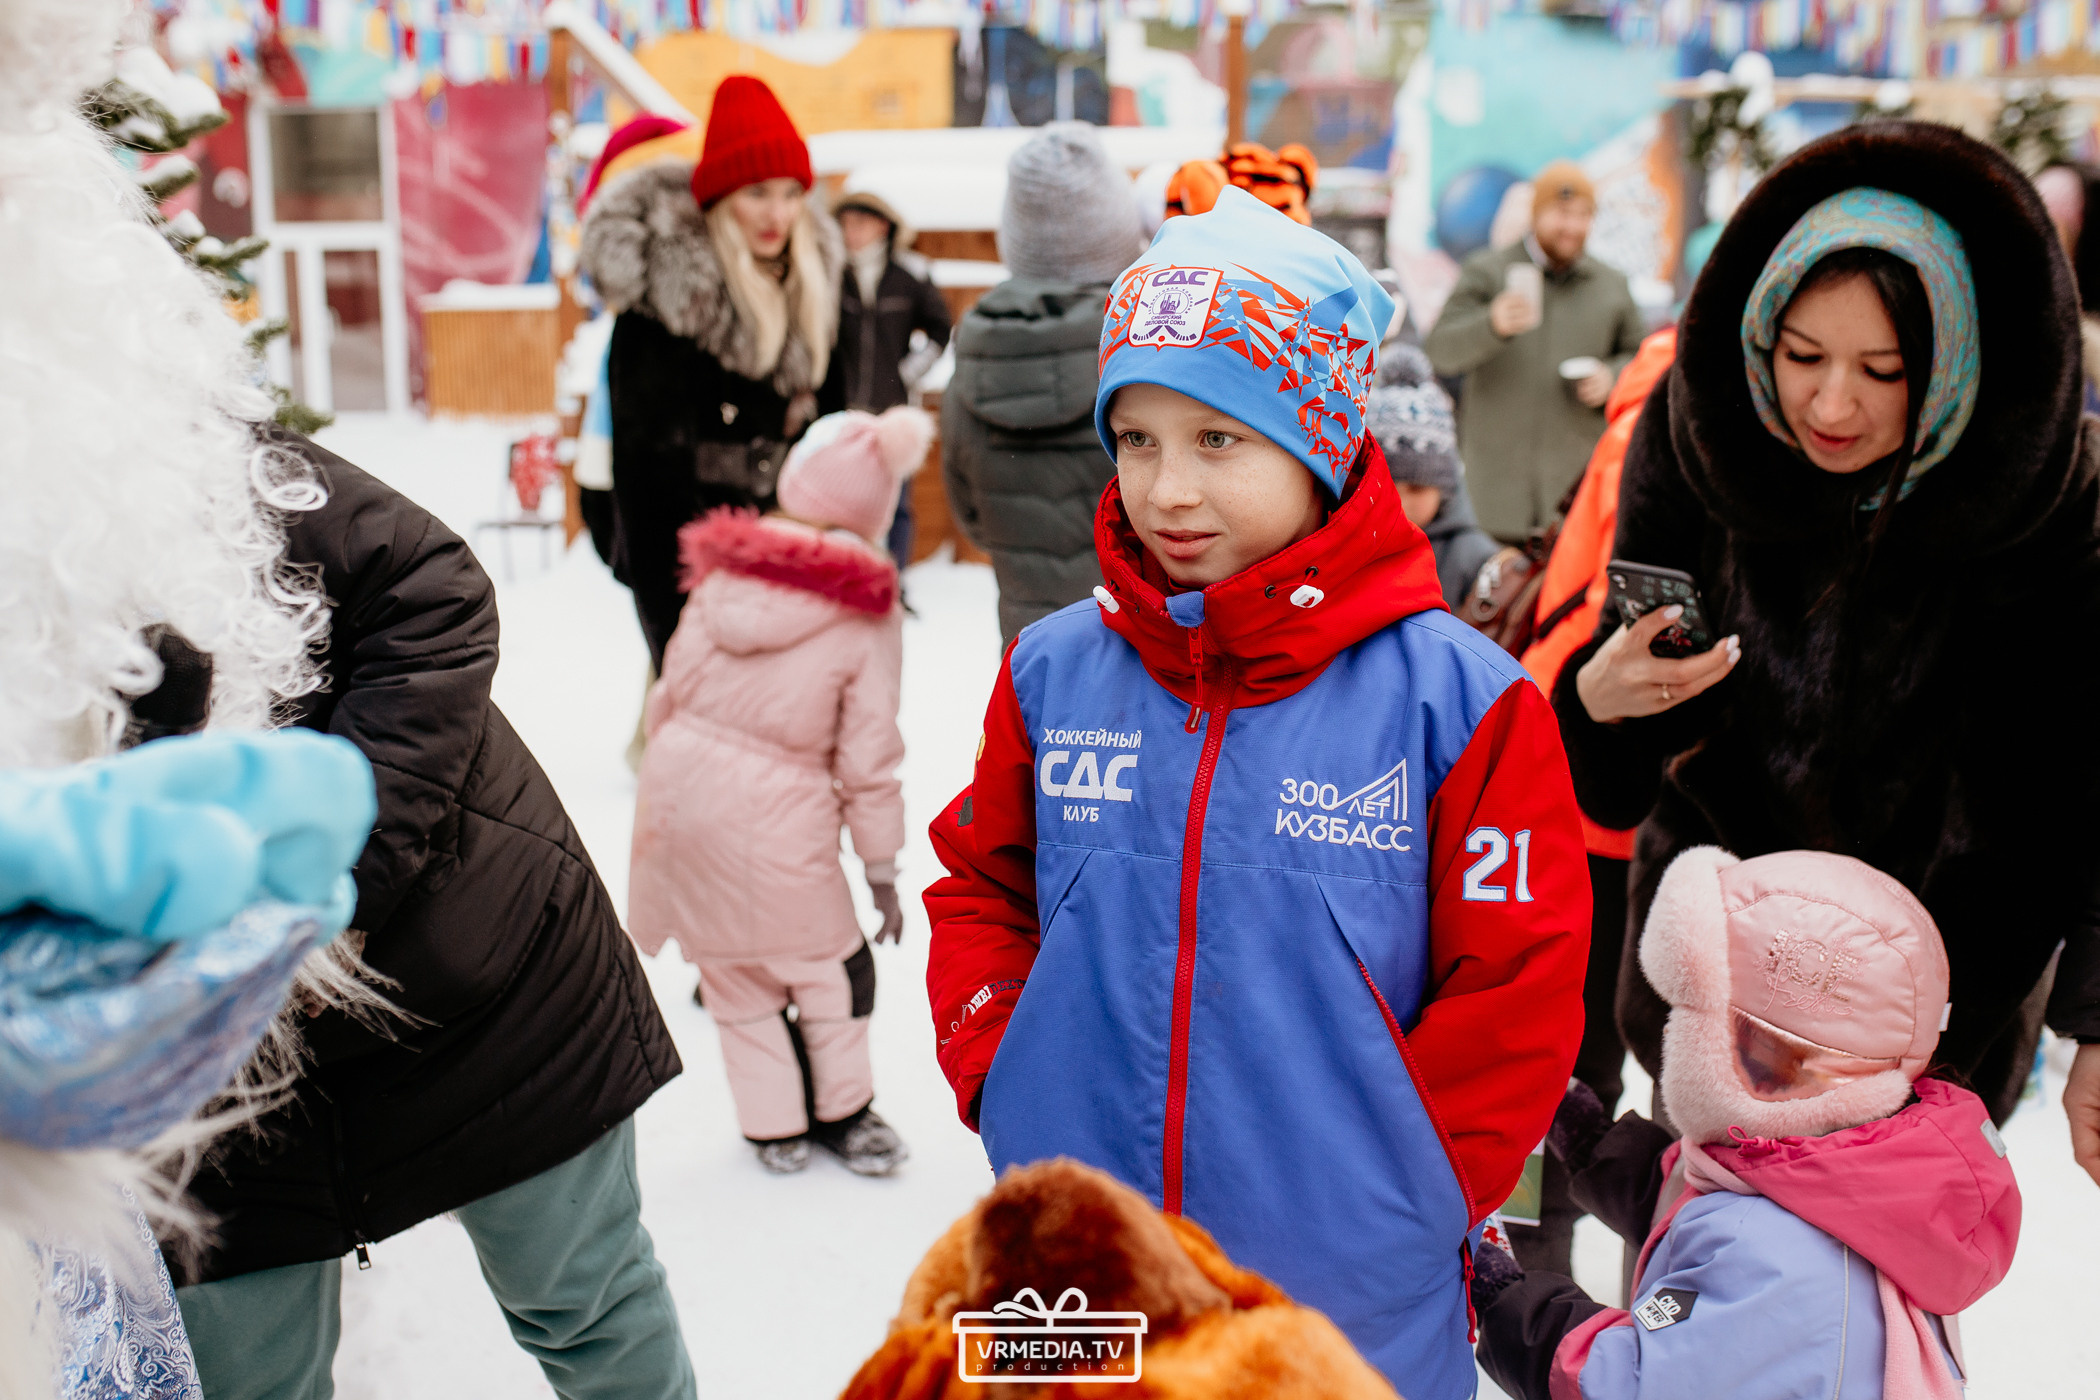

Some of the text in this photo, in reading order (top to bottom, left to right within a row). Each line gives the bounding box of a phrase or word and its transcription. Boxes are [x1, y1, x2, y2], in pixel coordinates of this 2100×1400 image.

[1152, 270, 1209, 287] СДС
[1042, 727, 1142, 749] ХОККЕЙНЫЙ
[1040, 750, 1139, 802] СДС
[1063, 805, 1100, 823] КЛУБ
[1279, 778, 1391, 819] 300 ЛЕТ
[1274, 808, 1414, 852] КУЗБАСС
[1462, 826, 1535, 903] 21
